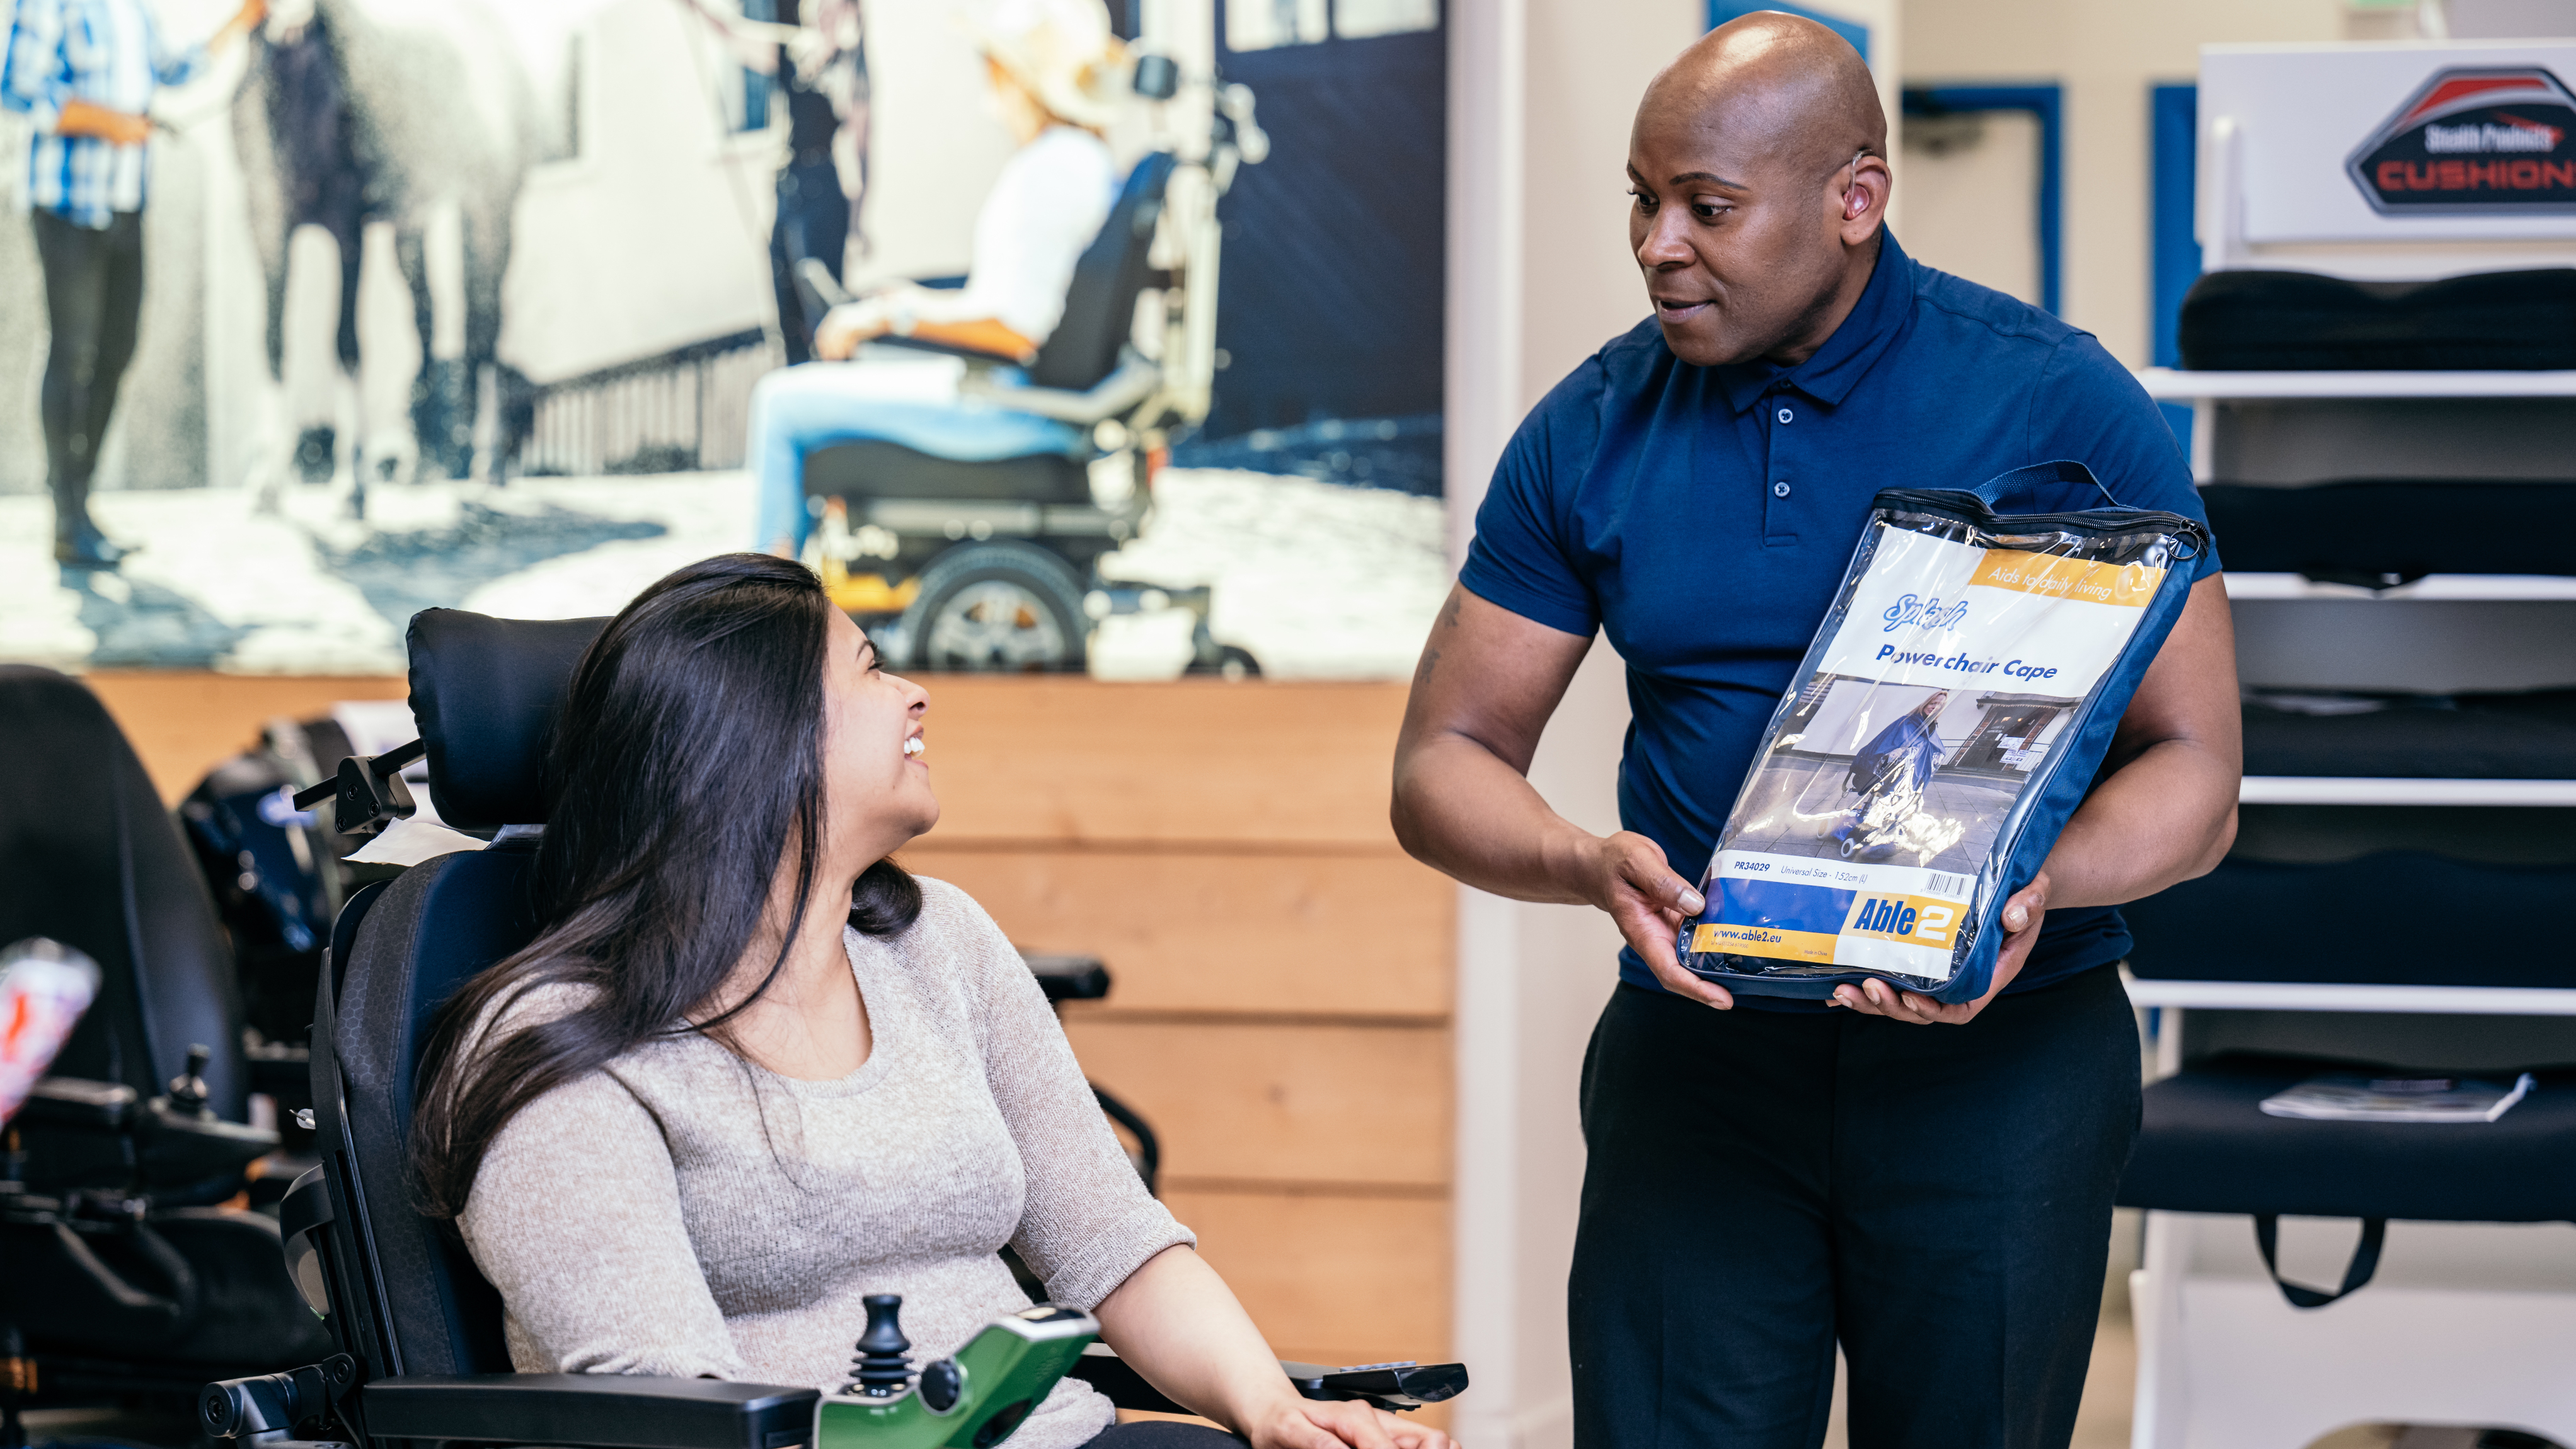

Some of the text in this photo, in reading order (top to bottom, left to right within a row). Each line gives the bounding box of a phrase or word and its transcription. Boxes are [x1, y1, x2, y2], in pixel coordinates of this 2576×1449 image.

[2377, 159, 2576, 190] CUSHION
[1987, 567, 2112, 600] Aids to daily living
[1883, 593, 1969, 632] Splash
[1876, 644, 2057, 682] Powerchair Cape
[1734, 861, 1770, 872] PR34029
[1781, 866, 1812, 876] Universal
[1813, 869, 1827, 878] Size
[1835, 871, 1858, 882] 152cm
[1859, 874, 1868, 884] (L)
[1713, 929, 1782, 943] www.able2.eu
